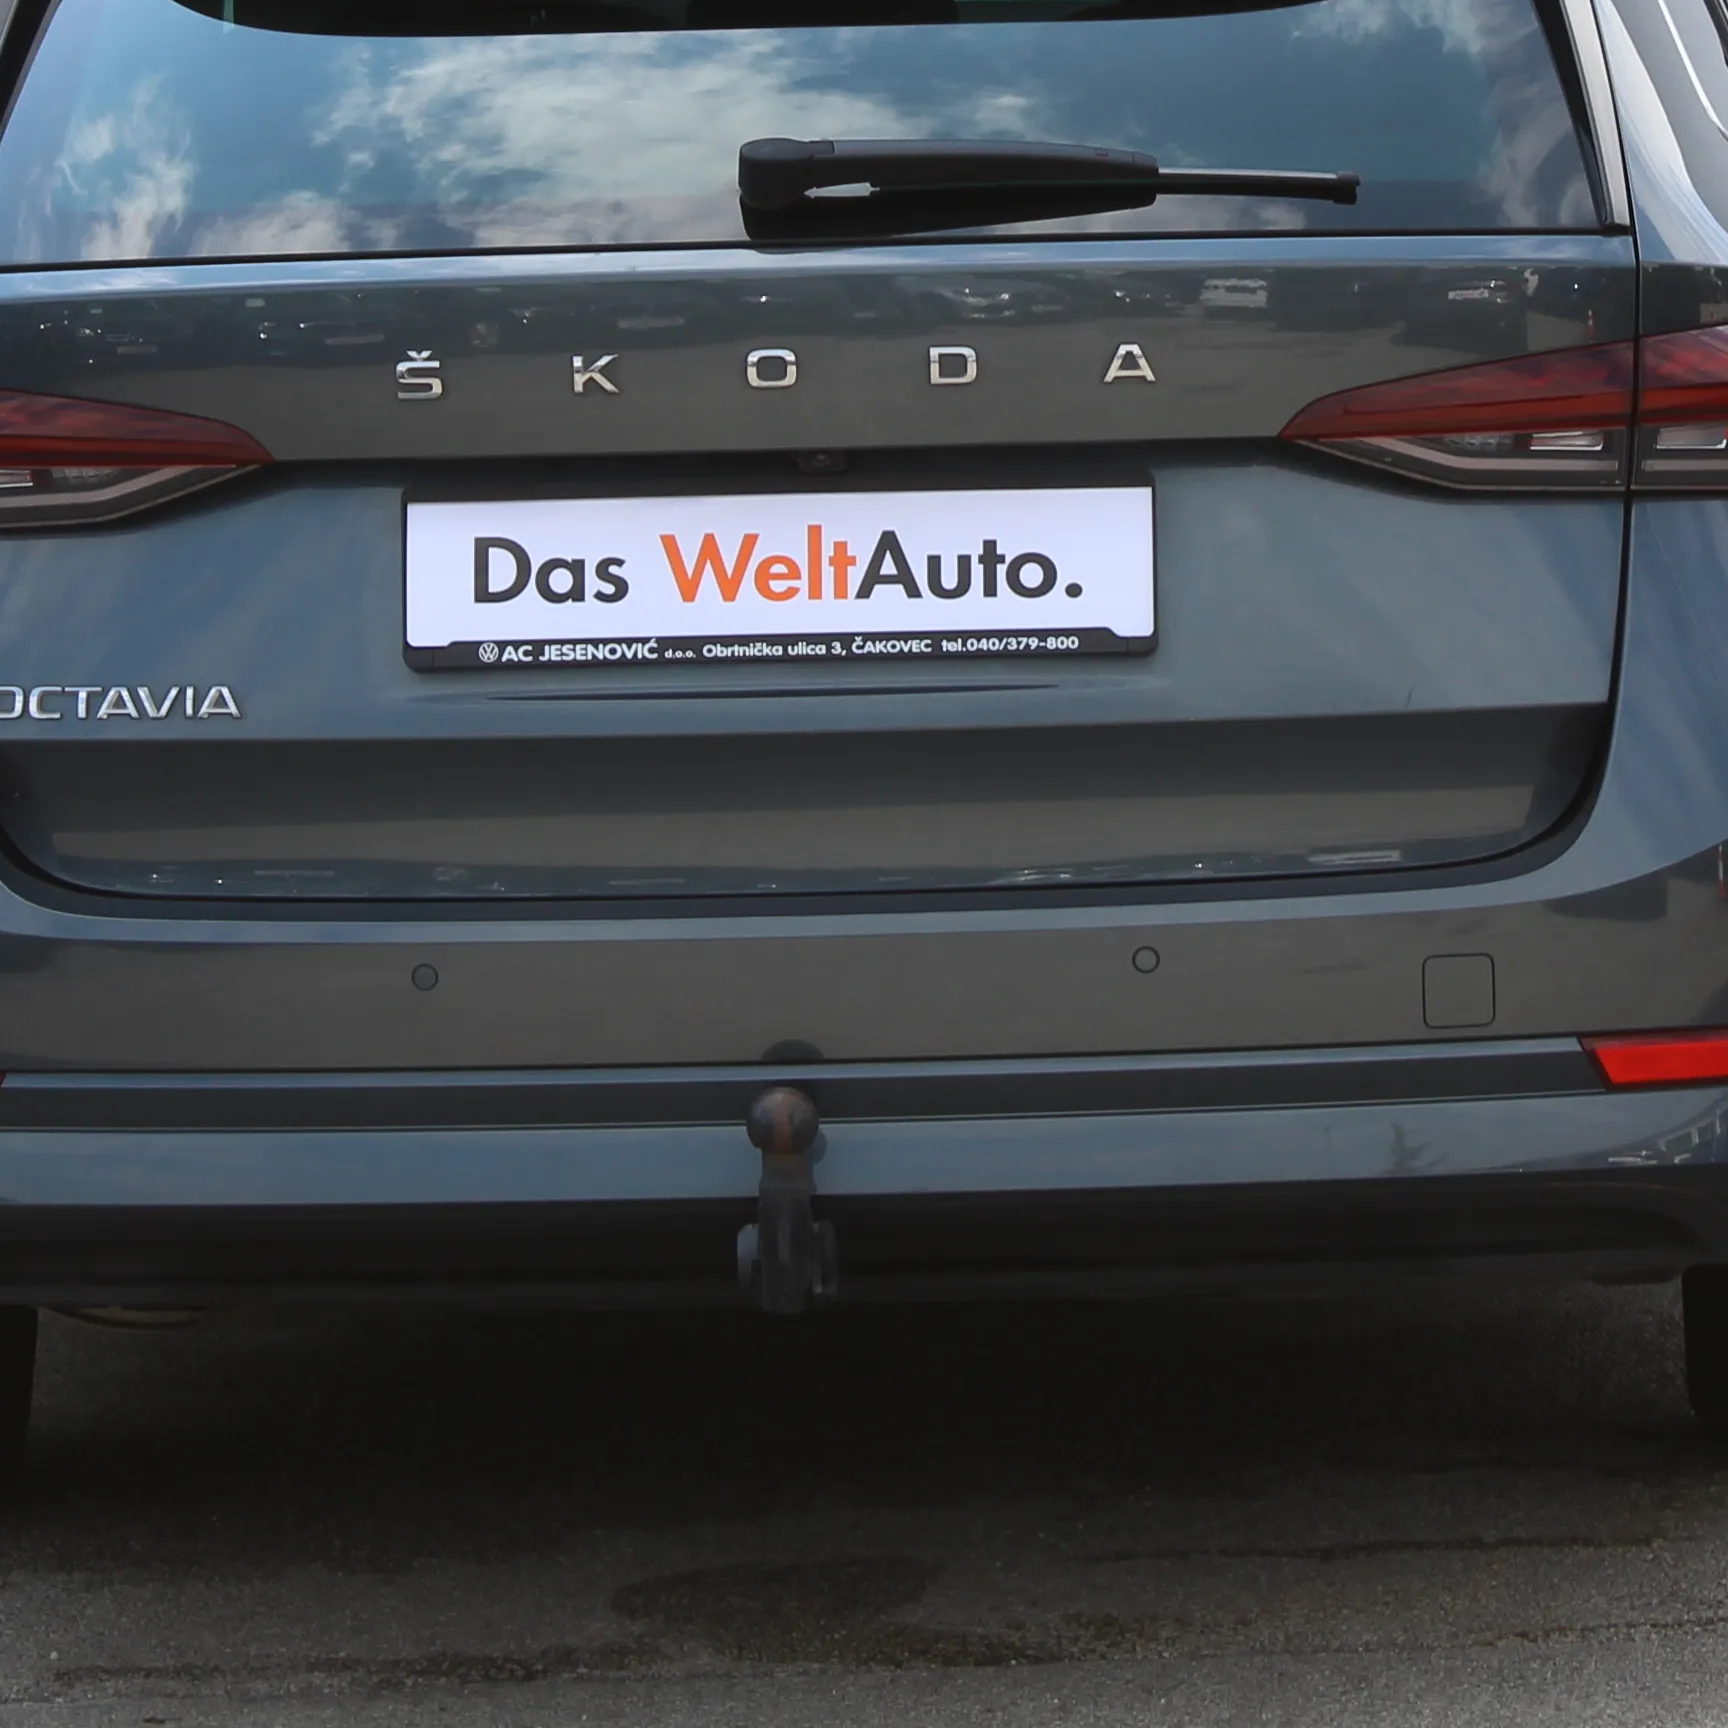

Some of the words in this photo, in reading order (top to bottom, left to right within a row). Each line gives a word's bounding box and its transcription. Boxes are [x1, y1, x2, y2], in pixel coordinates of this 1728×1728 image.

[394, 342, 1157, 400] ŠKODA
[473, 536, 630, 605] Das
[659, 524, 1084, 604] WeltAuto.
[501, 645, 534, 663] AC
[538, 638, 659, 663] JESENOVIĆ
[664, 648, 697, 660] d.o.o.
[702, 642, 783, 659] Obrtnička
[787, 640, 827, 656] ulica
[830, 641, 847, 657] 3,
[851, 635, 933, 655] ČAKOVEC
[940, 635, 1079, 653] tel.040/379-800
